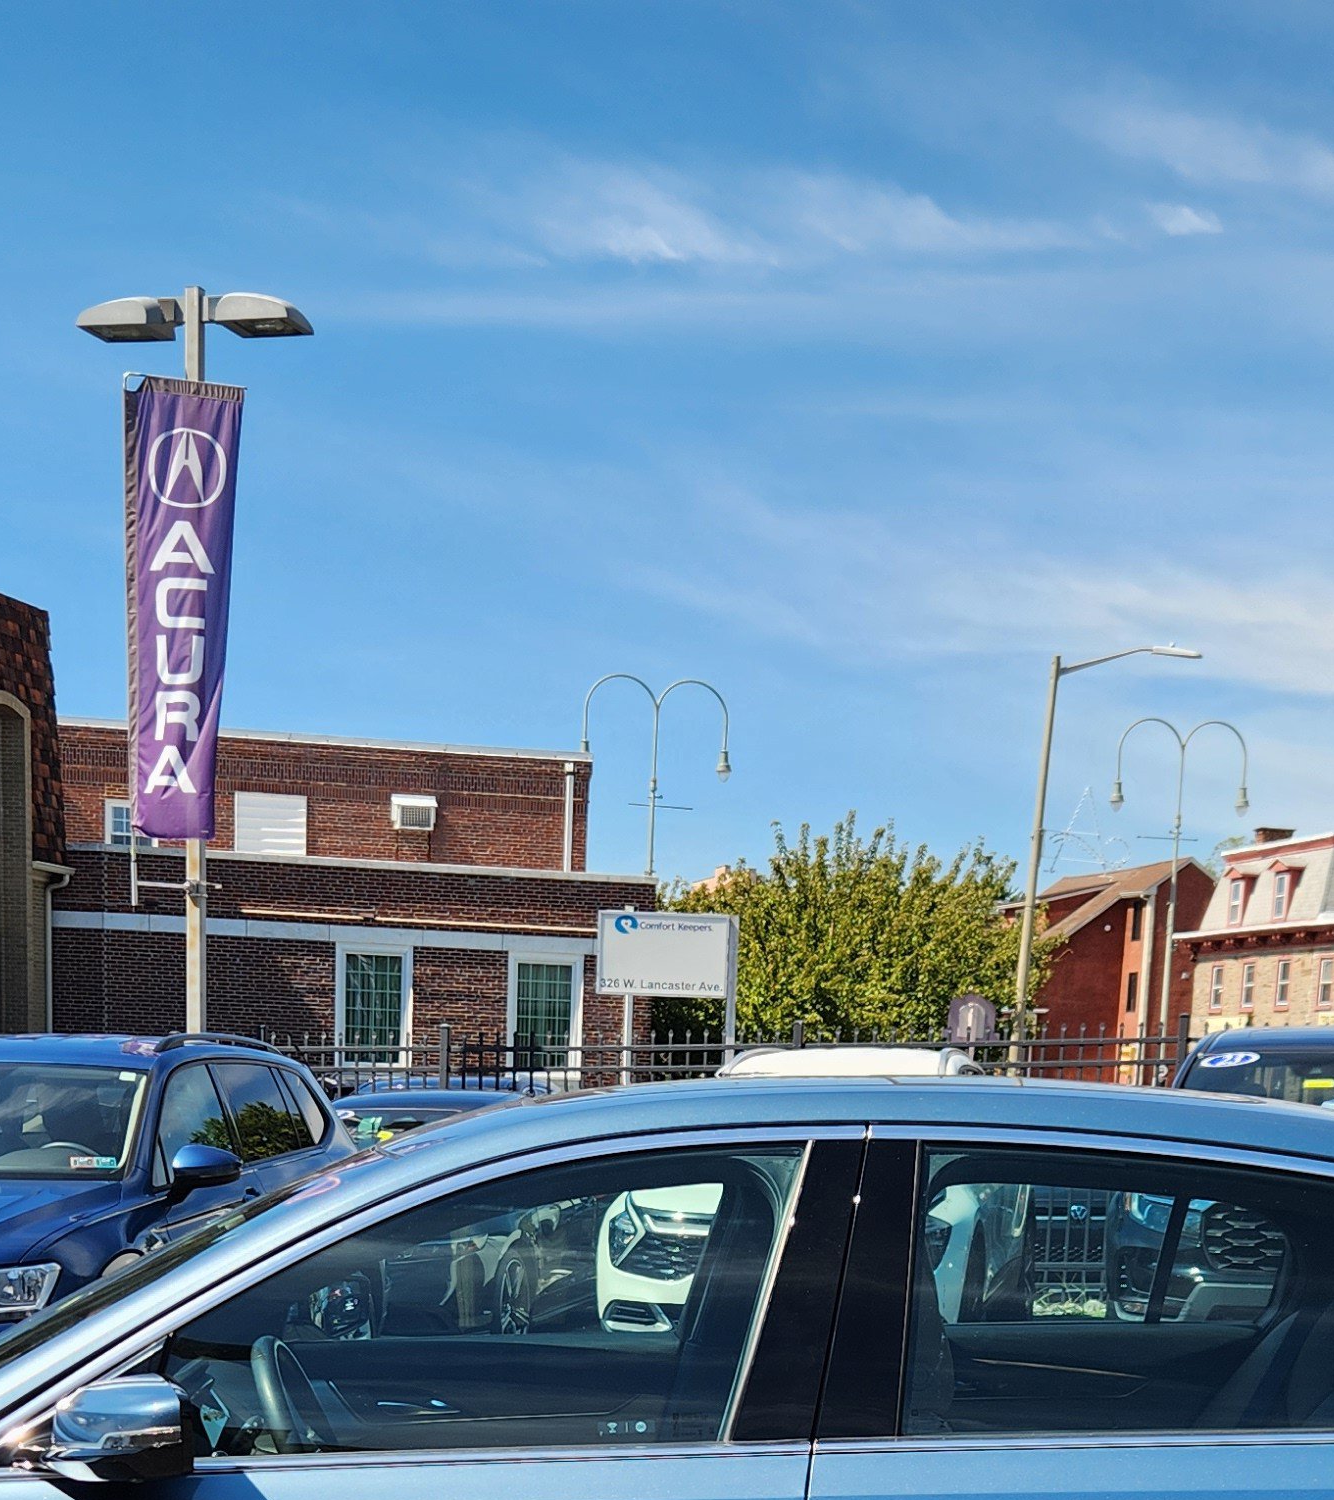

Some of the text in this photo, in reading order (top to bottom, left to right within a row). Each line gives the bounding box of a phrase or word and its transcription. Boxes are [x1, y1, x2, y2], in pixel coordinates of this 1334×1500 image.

[145, 520, 216, 795] ACURA
[639, 921, 675, 932] Comfort
[599, 978, 723, 992] 326 W. Lancaster Ave.
